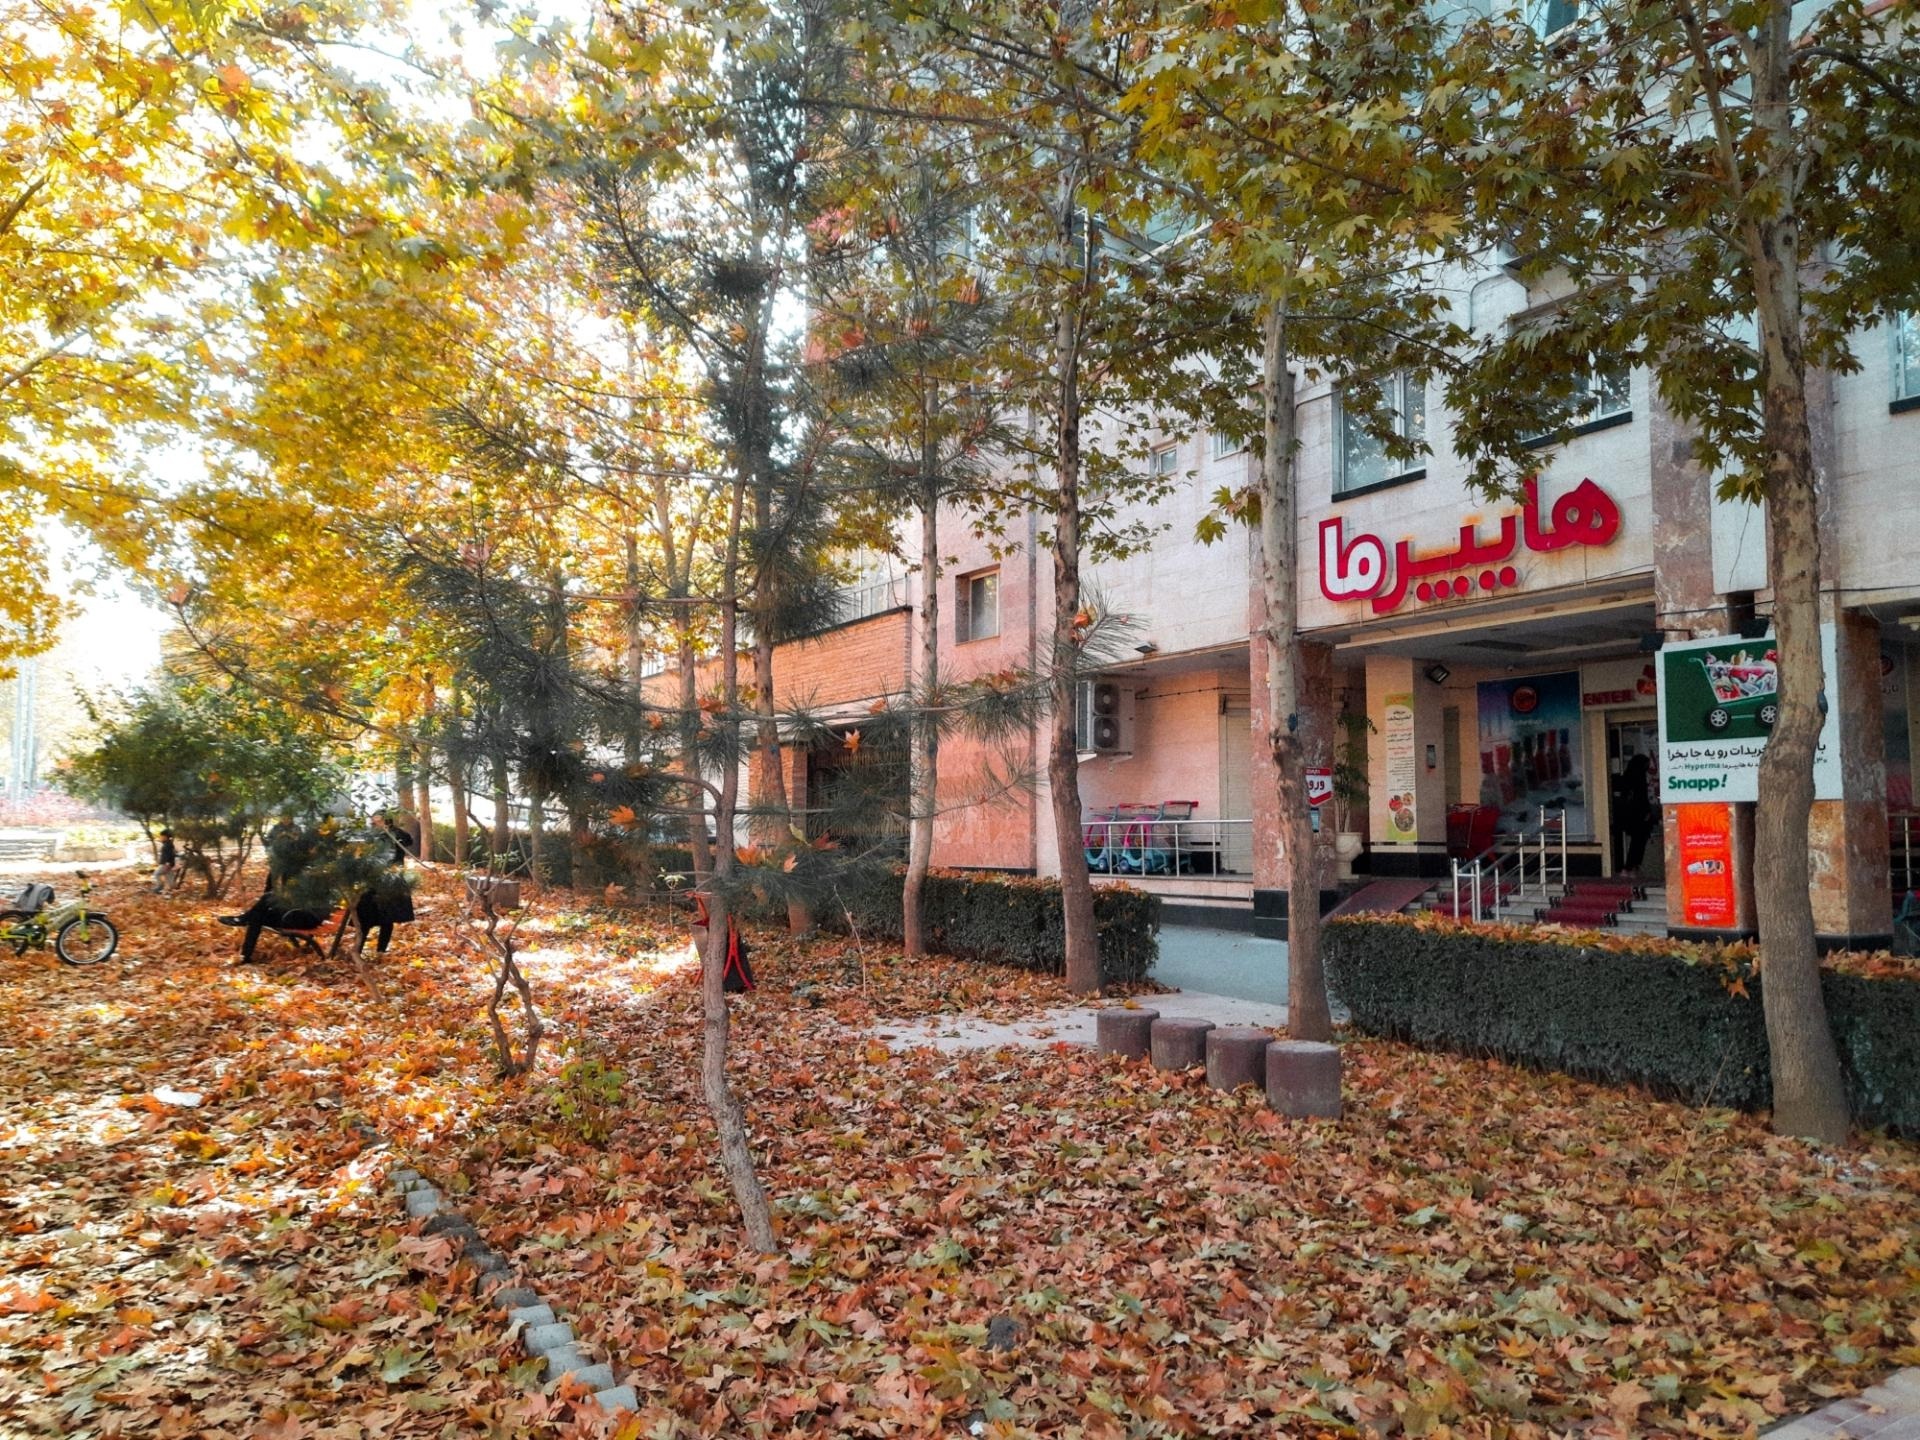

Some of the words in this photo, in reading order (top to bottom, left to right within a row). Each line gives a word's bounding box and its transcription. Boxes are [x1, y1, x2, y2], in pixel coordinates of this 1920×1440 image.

[1318, 475, 1621, 614] هایپرما
[1690, 747, 1702, 760] جا
[1668, 773, 1728, 791] Snapp!
